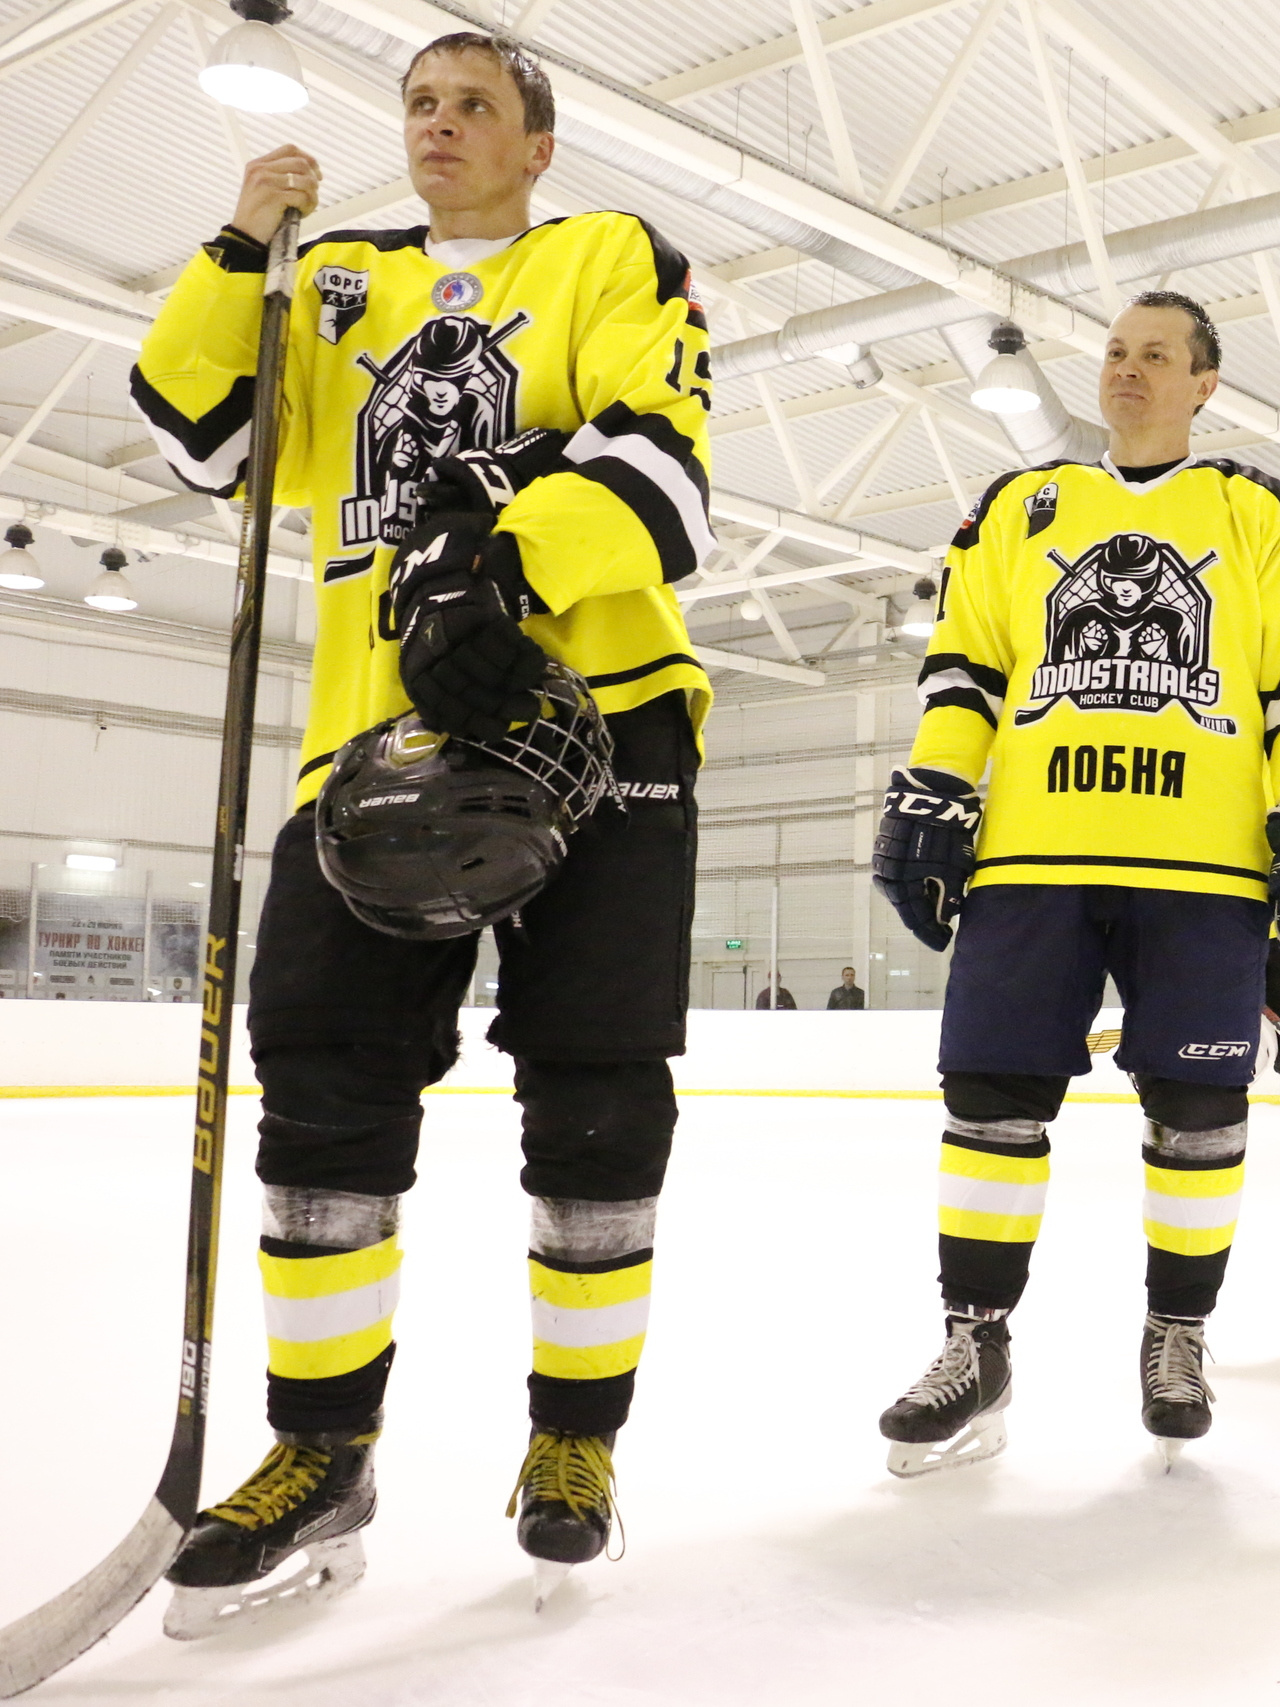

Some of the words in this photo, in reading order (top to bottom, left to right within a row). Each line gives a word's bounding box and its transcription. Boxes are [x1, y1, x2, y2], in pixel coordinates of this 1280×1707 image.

[1033, 658, 1217, 703] INDUSTRIALS
[1079, 693, 1124, 706] HOCKEY
[1129, 694, 1160, 708] CLUB
[1047, 744, 1186, 799] ЛОБНЯ
[359, 793, 420, 809] BAUER
[38, 931, 81, 949] ТУРНИР
[87, 934, 101, 950] ПО
[193, 933, 227, 1175] BAUER
[1186, 1043, 1247, 1057] CCM
[180, 1339, 198, 1399] 190
